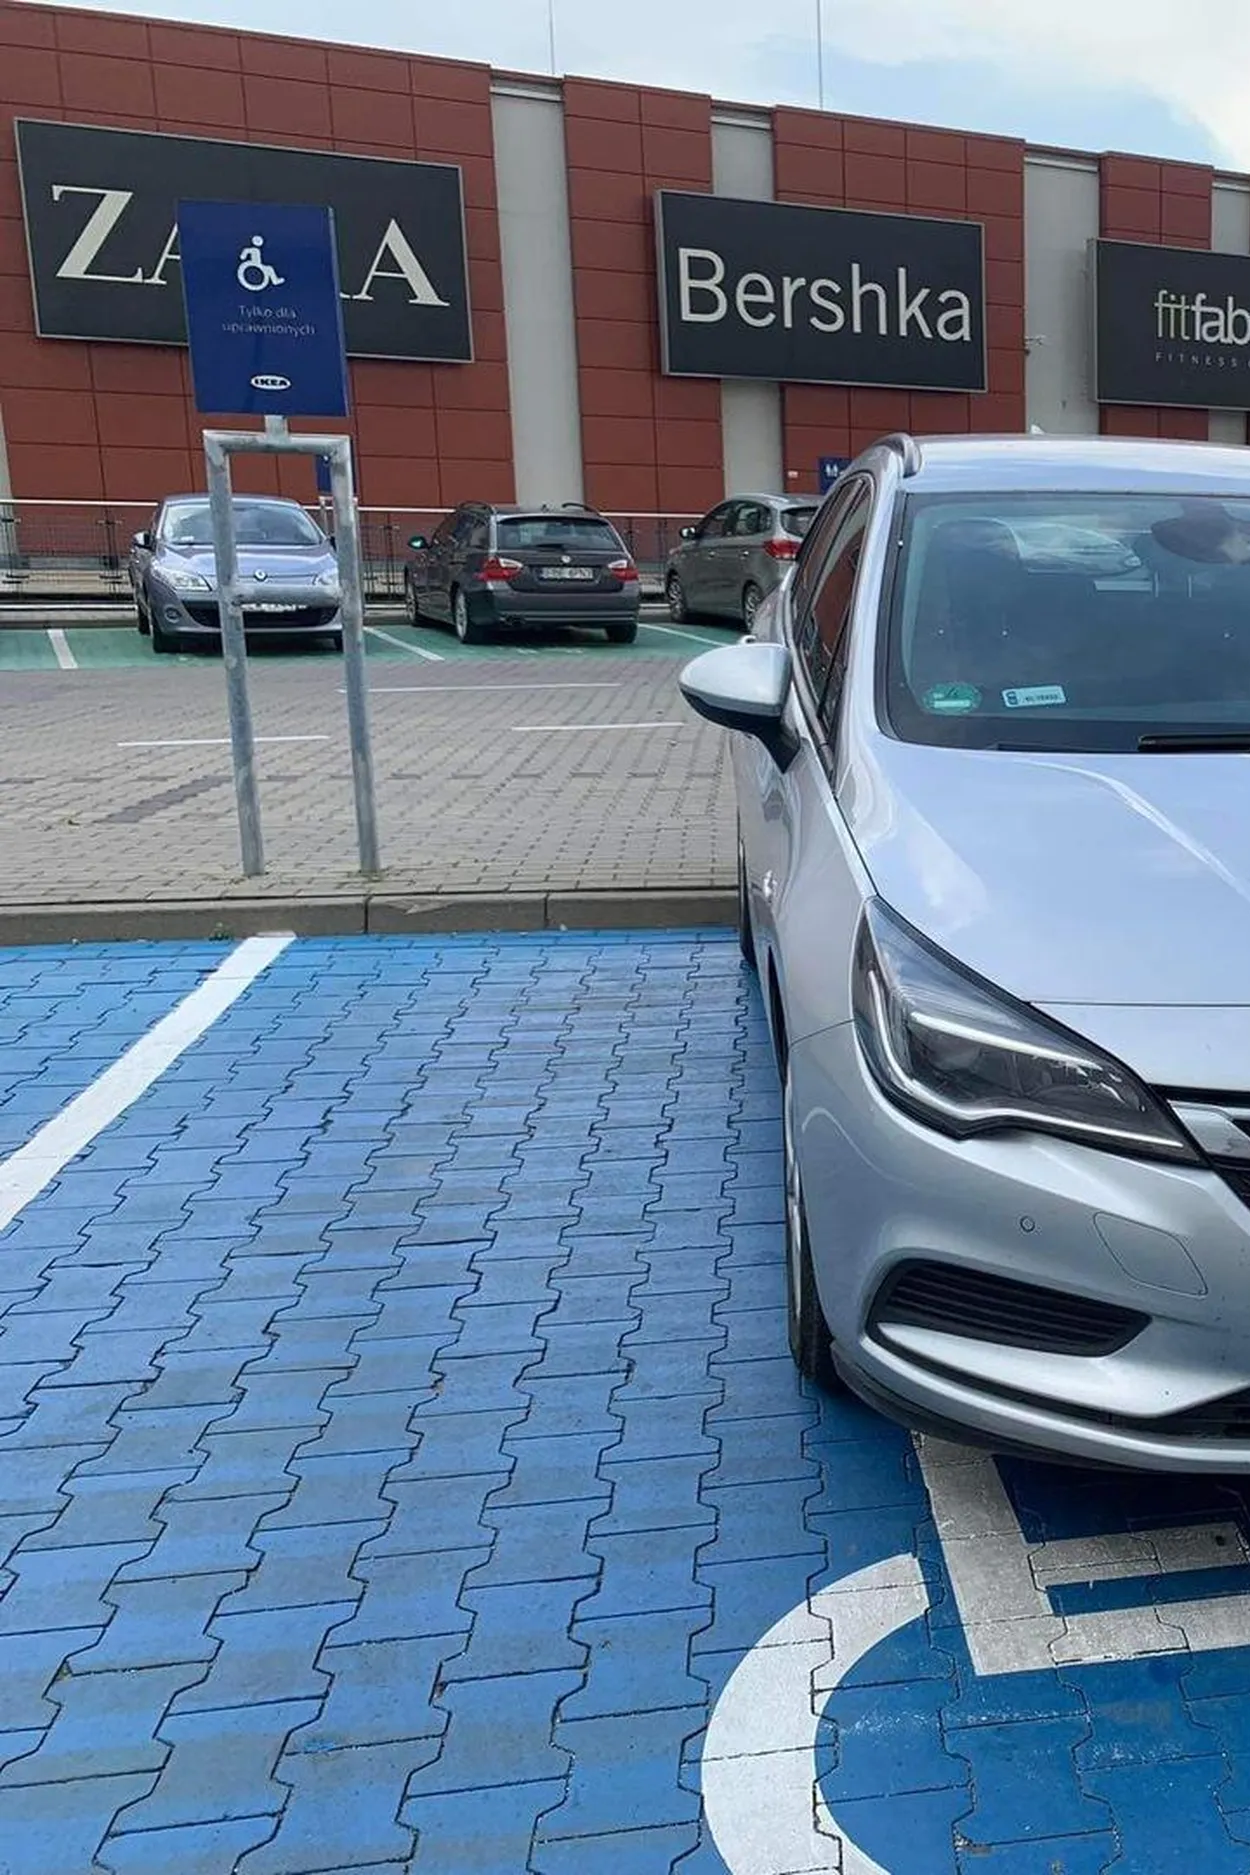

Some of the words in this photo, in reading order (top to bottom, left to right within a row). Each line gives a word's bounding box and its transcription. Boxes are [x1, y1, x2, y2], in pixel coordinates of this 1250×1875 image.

[51, 184, 451, 307] ZA
[678, 247, 971, 342] Bershka
[239, 305, 272, 319] Tylko
[275, 306, 296, 319] dla
[222, 322, 315, 338] uprawnionych
[1155, 352, 1238, 368] FITNESS
[254, 377, 289, 387] IKEA
